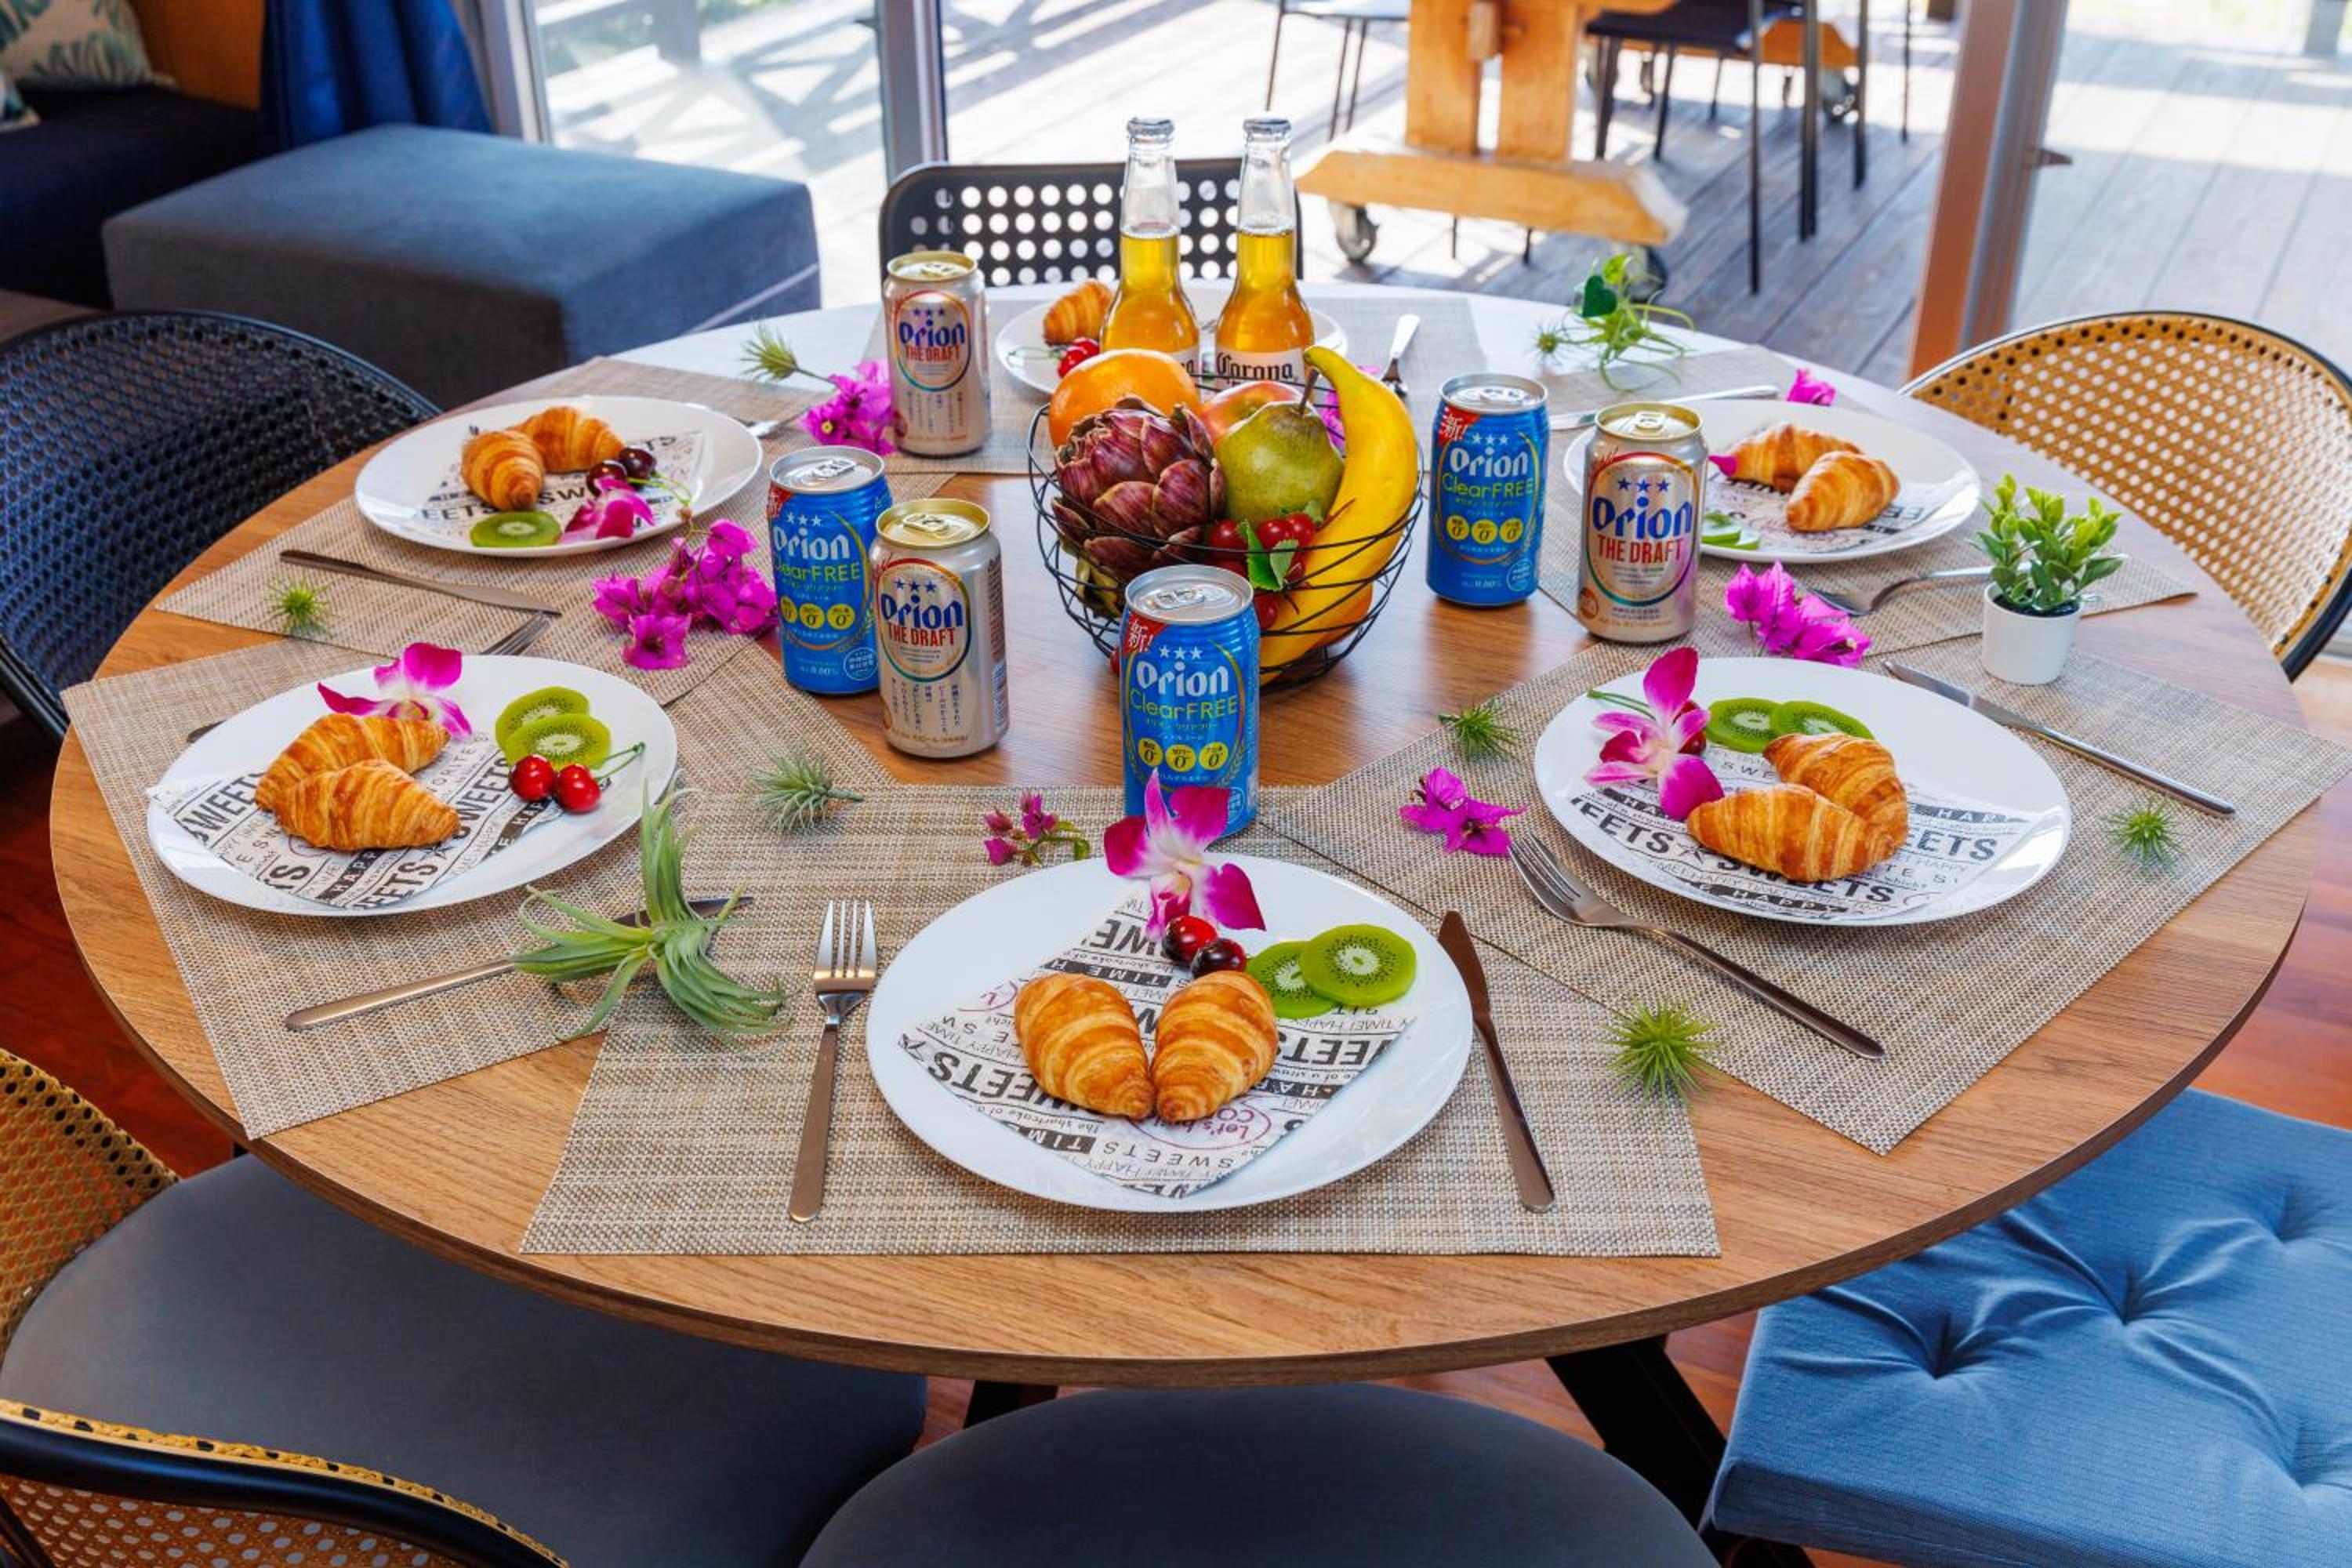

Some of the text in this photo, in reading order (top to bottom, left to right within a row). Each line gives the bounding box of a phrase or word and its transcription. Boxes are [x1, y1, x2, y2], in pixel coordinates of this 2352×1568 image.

[898, 320, 965, 347] Orion
[905, 345, 960, 361] THE DRAFT
[1217, 353, 1294, 380] Corona
[1450, 447, 1528, 477] Orion
[1592, 496, 1693, 539] Orion
[773, 526, 850, 561] Orion
[1598, 534, 1683, 563] THE DRAFT
[881, 593, 963, 630] Orion
[888, 622, 955, 647] THE DRAFT
[1136, 661, 1229, 697] Orion
[1088, 964, 1160, 987] TIME
[928, 1051, 1094, 1113] WEETS
[1203, 1120, 1249, 1138] Let's
[1102, 1141, 1233, 1169] SWEETS
